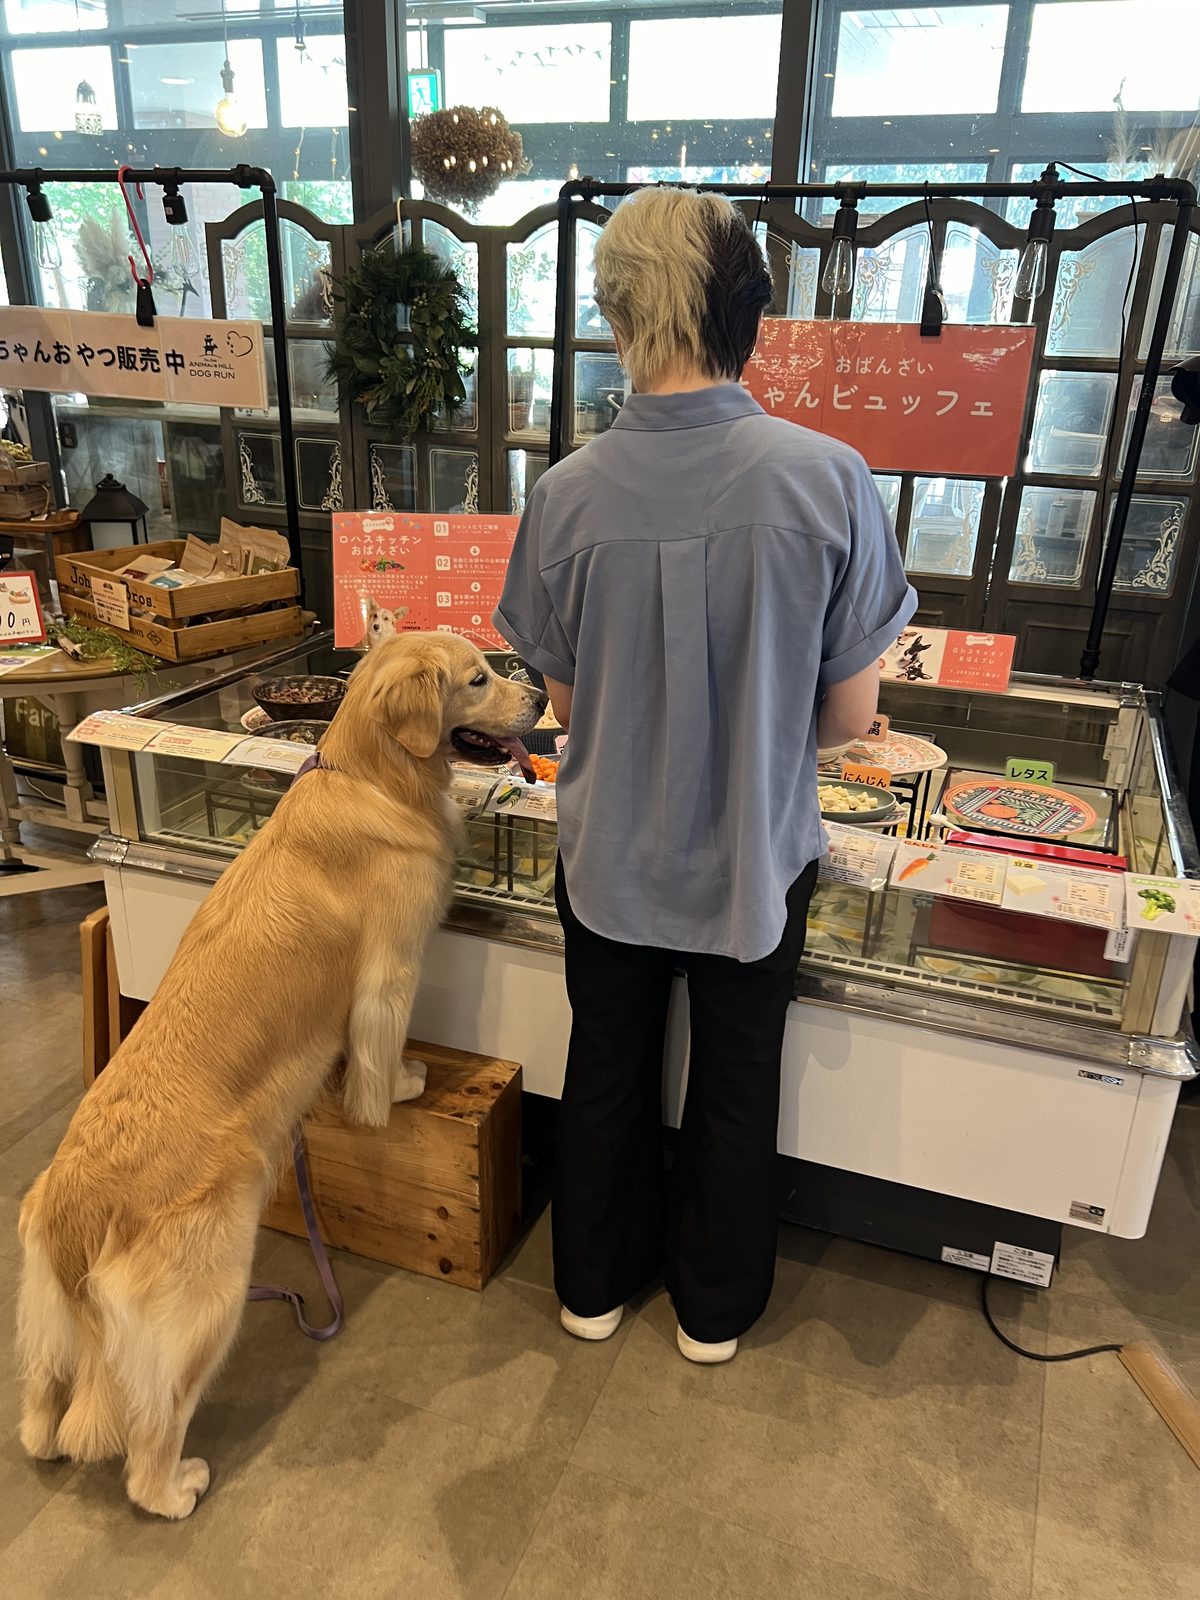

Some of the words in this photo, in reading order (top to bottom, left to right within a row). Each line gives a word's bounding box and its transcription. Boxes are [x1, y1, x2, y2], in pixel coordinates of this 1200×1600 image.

[835, 356, 934, 377] おばんざい
[190, 369, 212, 378] DOG
[213, 370, 236, 379] RUN
[436, 524, 447, 533] 01
[339, 534, 422, 545] ロハスキッチン
[351, 545, 410, 556] おばんざい
[437, 558, 449, 568] 02
[71, 566, 91, 589] Joh
[438, 594, 450, 604] 03
[1011, 767, 1048, 780] レタス
[843, 772, 887, 788] にんじん
